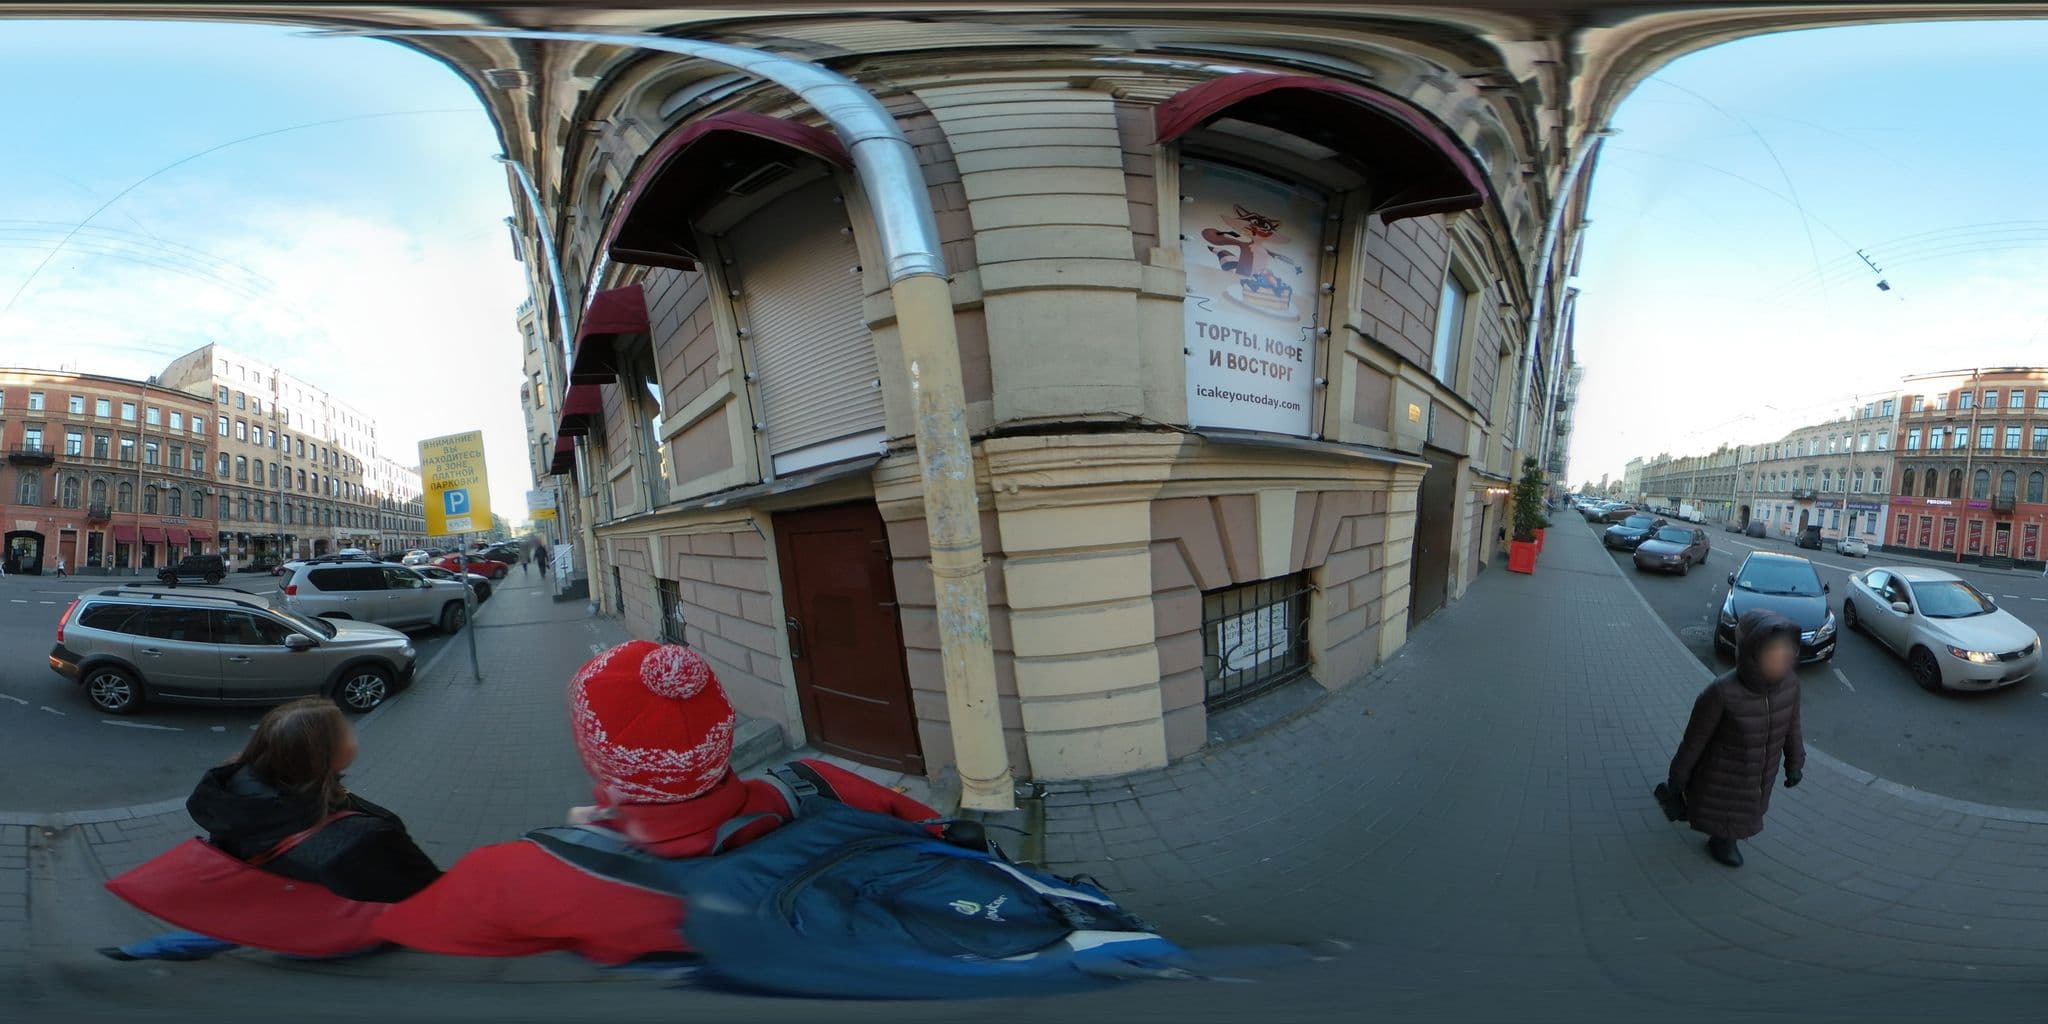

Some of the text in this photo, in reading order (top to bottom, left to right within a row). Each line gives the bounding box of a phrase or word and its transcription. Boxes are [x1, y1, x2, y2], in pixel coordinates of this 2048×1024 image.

[1195, 321, 1303, 362] ТОРТЫ, КОФЕ
[1209, 349, 1293, 381] И ВОСТОРГ
[1196, 384, 1300, 411] icakeyoutoday.com
[443, 446, 459, 454] ВЫ
[422, 450, 481, 466] НАХОДИТЕСЬ
[445, 461, 468, 470] ЗОНЕ
[432, 467, 474, 480] ПЛАТНОЙ
[430, 476, 479, 490] ПАРКОВКИ
